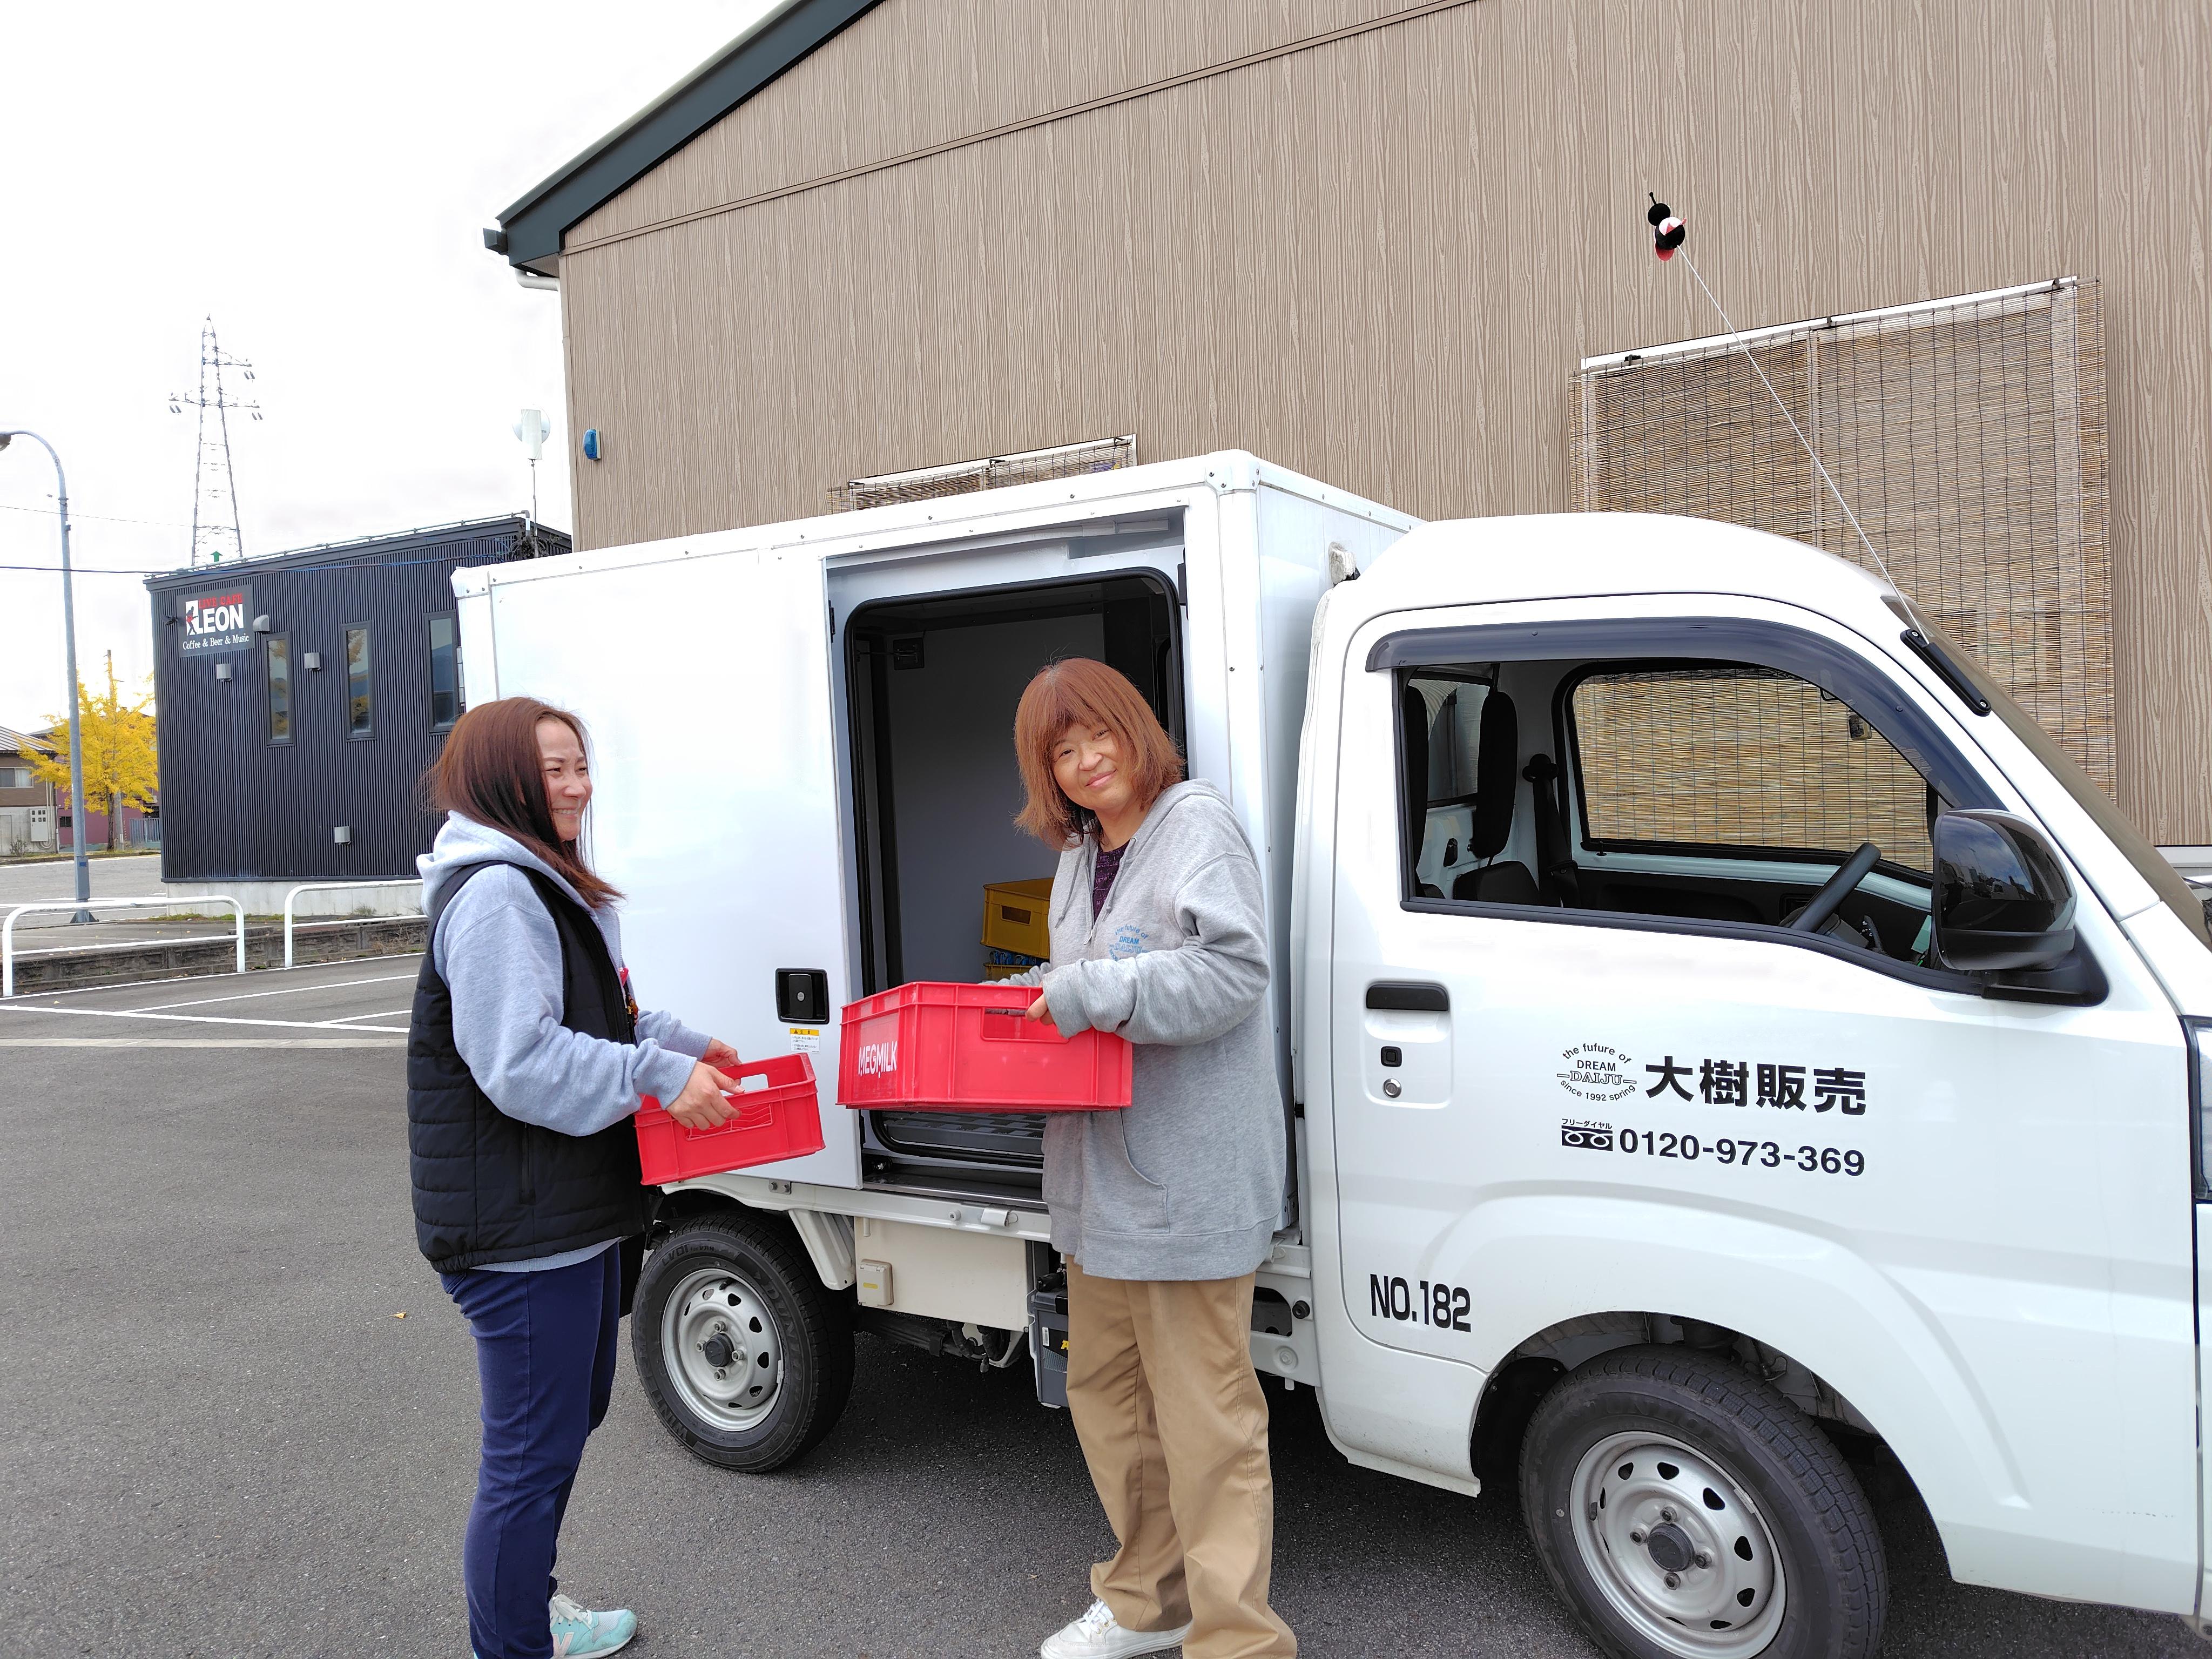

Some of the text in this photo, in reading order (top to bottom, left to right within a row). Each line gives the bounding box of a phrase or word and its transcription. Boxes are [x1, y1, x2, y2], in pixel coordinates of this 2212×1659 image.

[198, 592, 242, 609] LIVE CAFE
[183, 633, 249, 650] Coffee & Beer & Music
[1119, 936, 1139, 945] DREAM
[858, 1041, 898, 1078] MEGMILK
[1562, 1047, 1579, 1059] the
[1618, 1054, 1632, 1064] of
[1577, 1060, 1616, 1072] DREAM
[1570, 1070, 1623, 1085] DAIJU
[1645, 1056, 1866, 1116] 大樹販売
[1560, 1080, 1636, 1101] since 1992 spring
[1562, 1118, 1613, 1129] フリーダイヤル
[1620, 1128, 1865, 1177] 0120-973-369
[1370, 1273, 1472, 1333] NO.182
